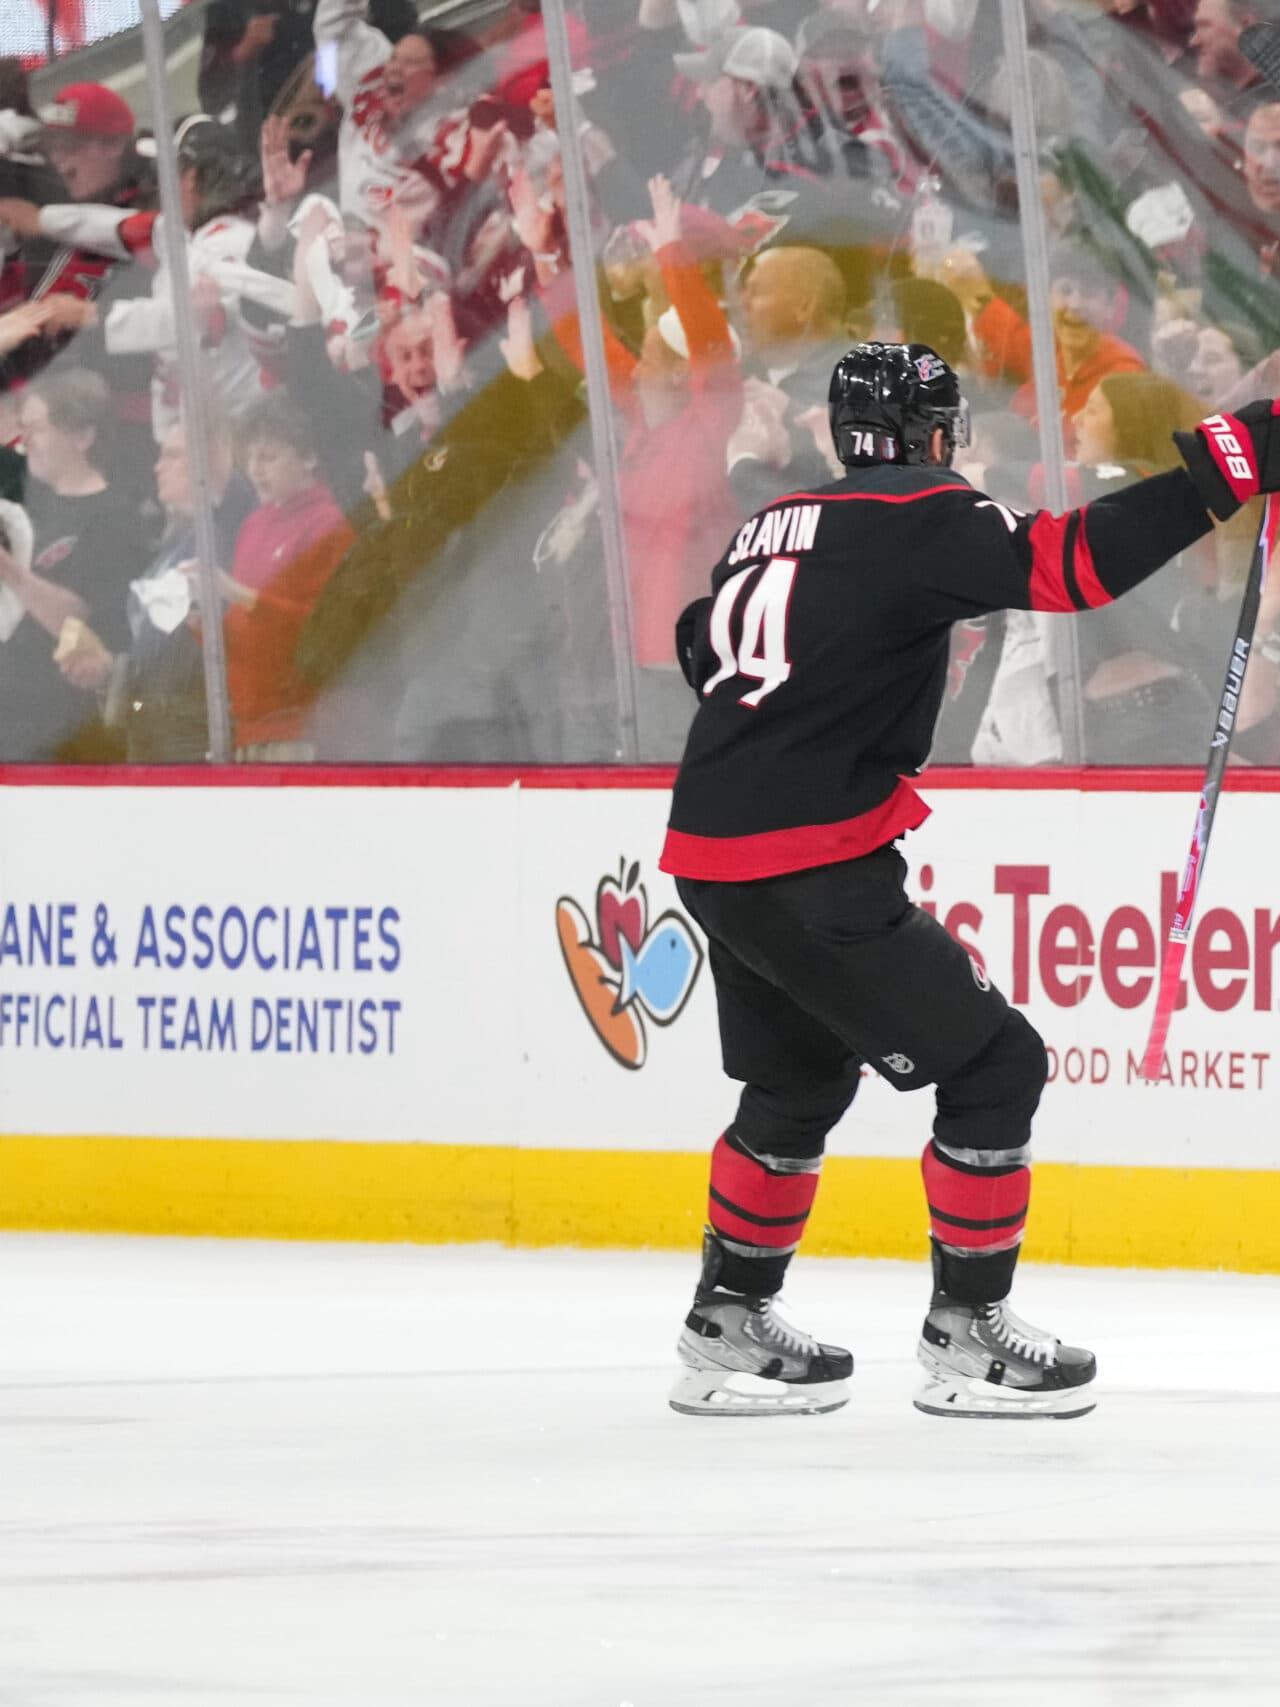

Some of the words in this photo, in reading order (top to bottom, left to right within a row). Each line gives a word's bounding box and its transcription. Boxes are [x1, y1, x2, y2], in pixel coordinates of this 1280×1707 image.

[851, 431, 875, 457] 74
[728, 504, 823, 566] SLAVIN
[91, 902, 118, 968] &
[134, 904, 402, 972] ASSOCIATES
[137, 997, 237, 1052] TEAM
[250, 997, 402, 1055] DENTIST
